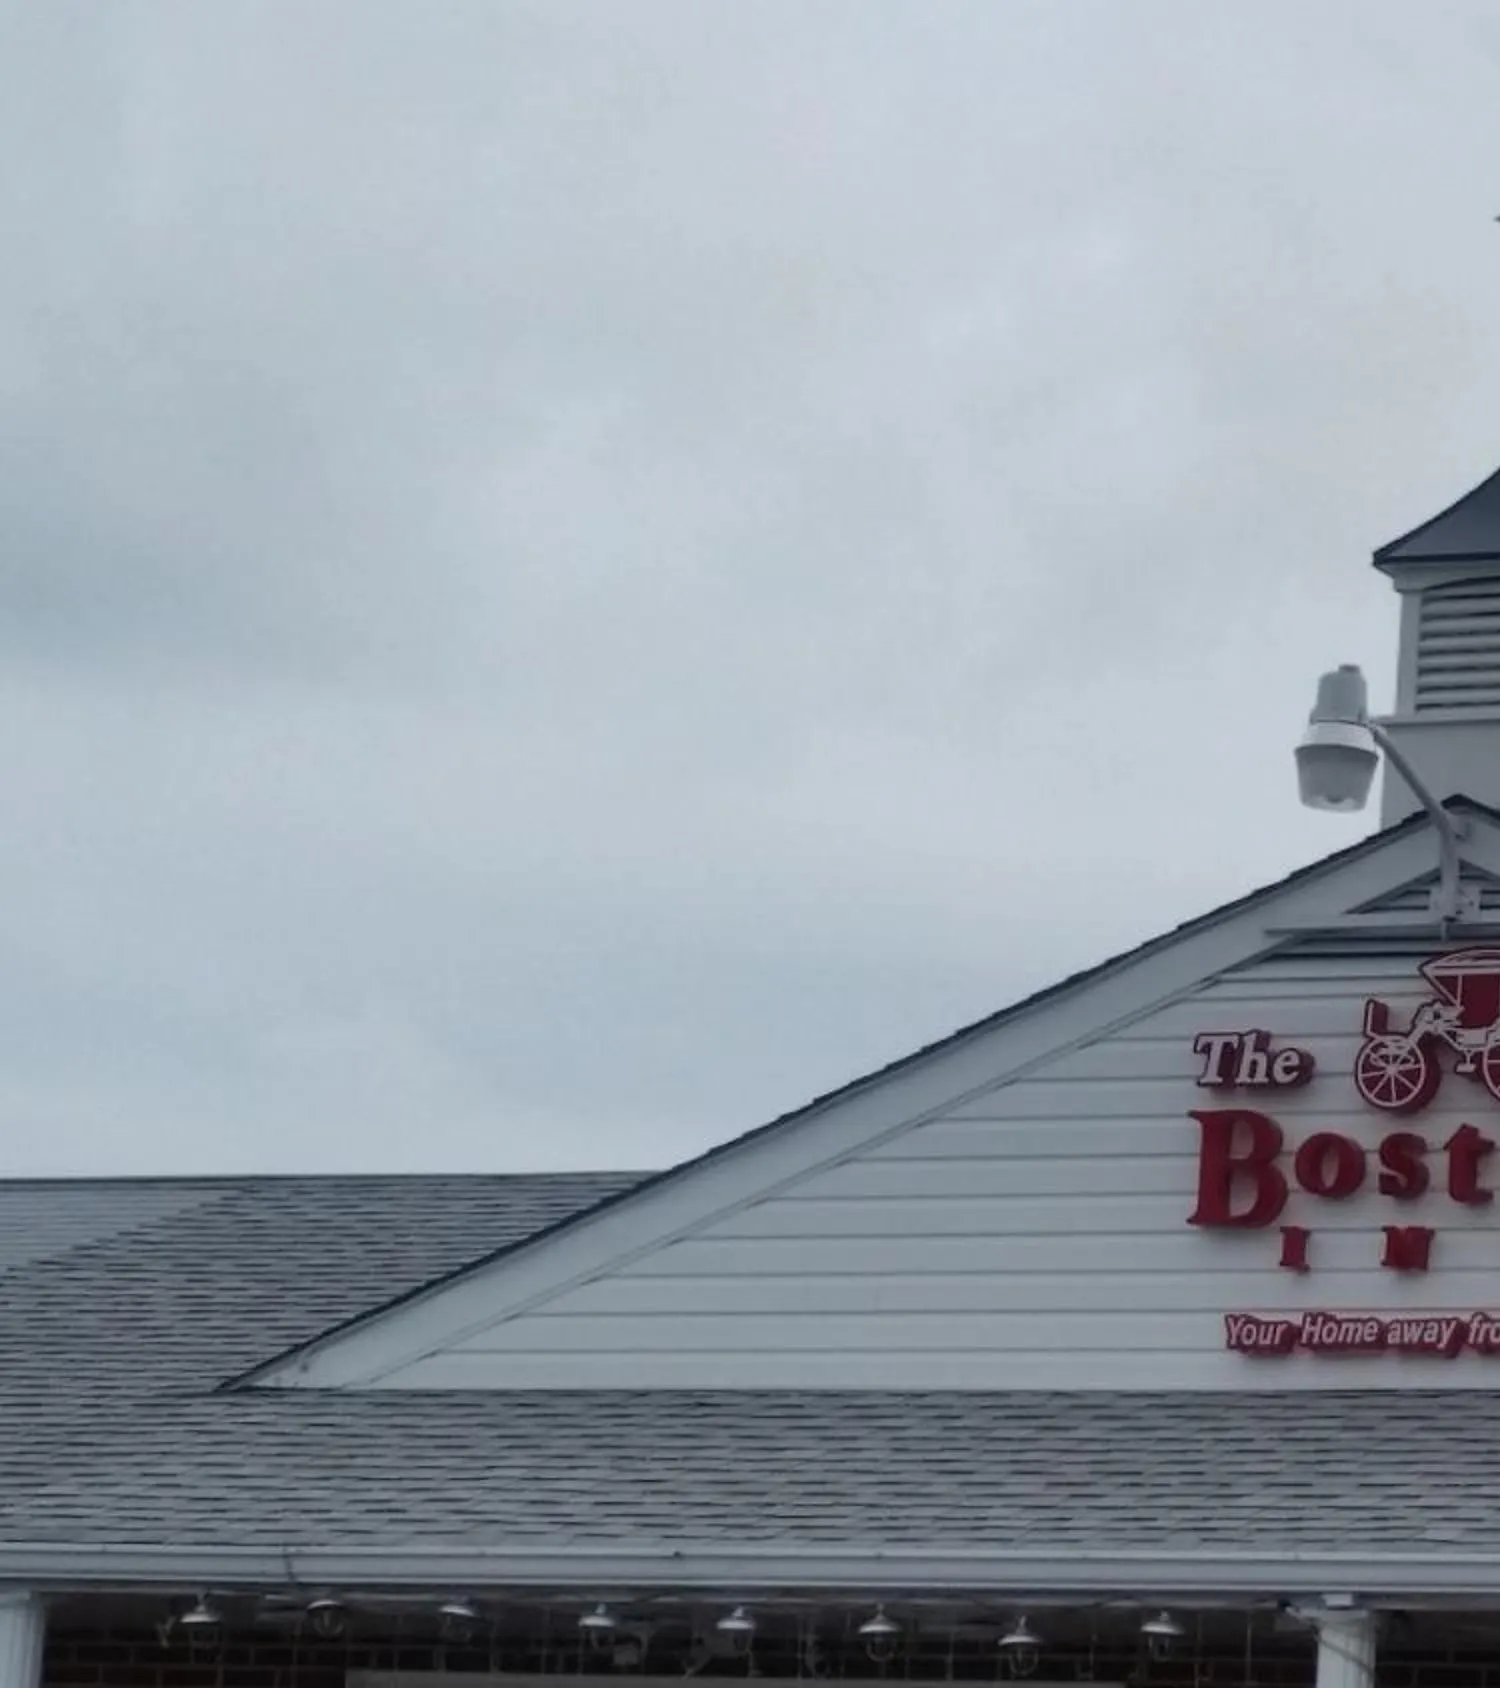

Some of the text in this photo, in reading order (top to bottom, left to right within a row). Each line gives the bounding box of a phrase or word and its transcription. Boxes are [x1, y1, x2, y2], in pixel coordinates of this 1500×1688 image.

[1195, 1031, 1306, 1087] The
[1225, 1314, 1290, 1349] Your
[1300, 1313, 1380, 1347] Home
[1386, 1316, 1458, 1352] away
